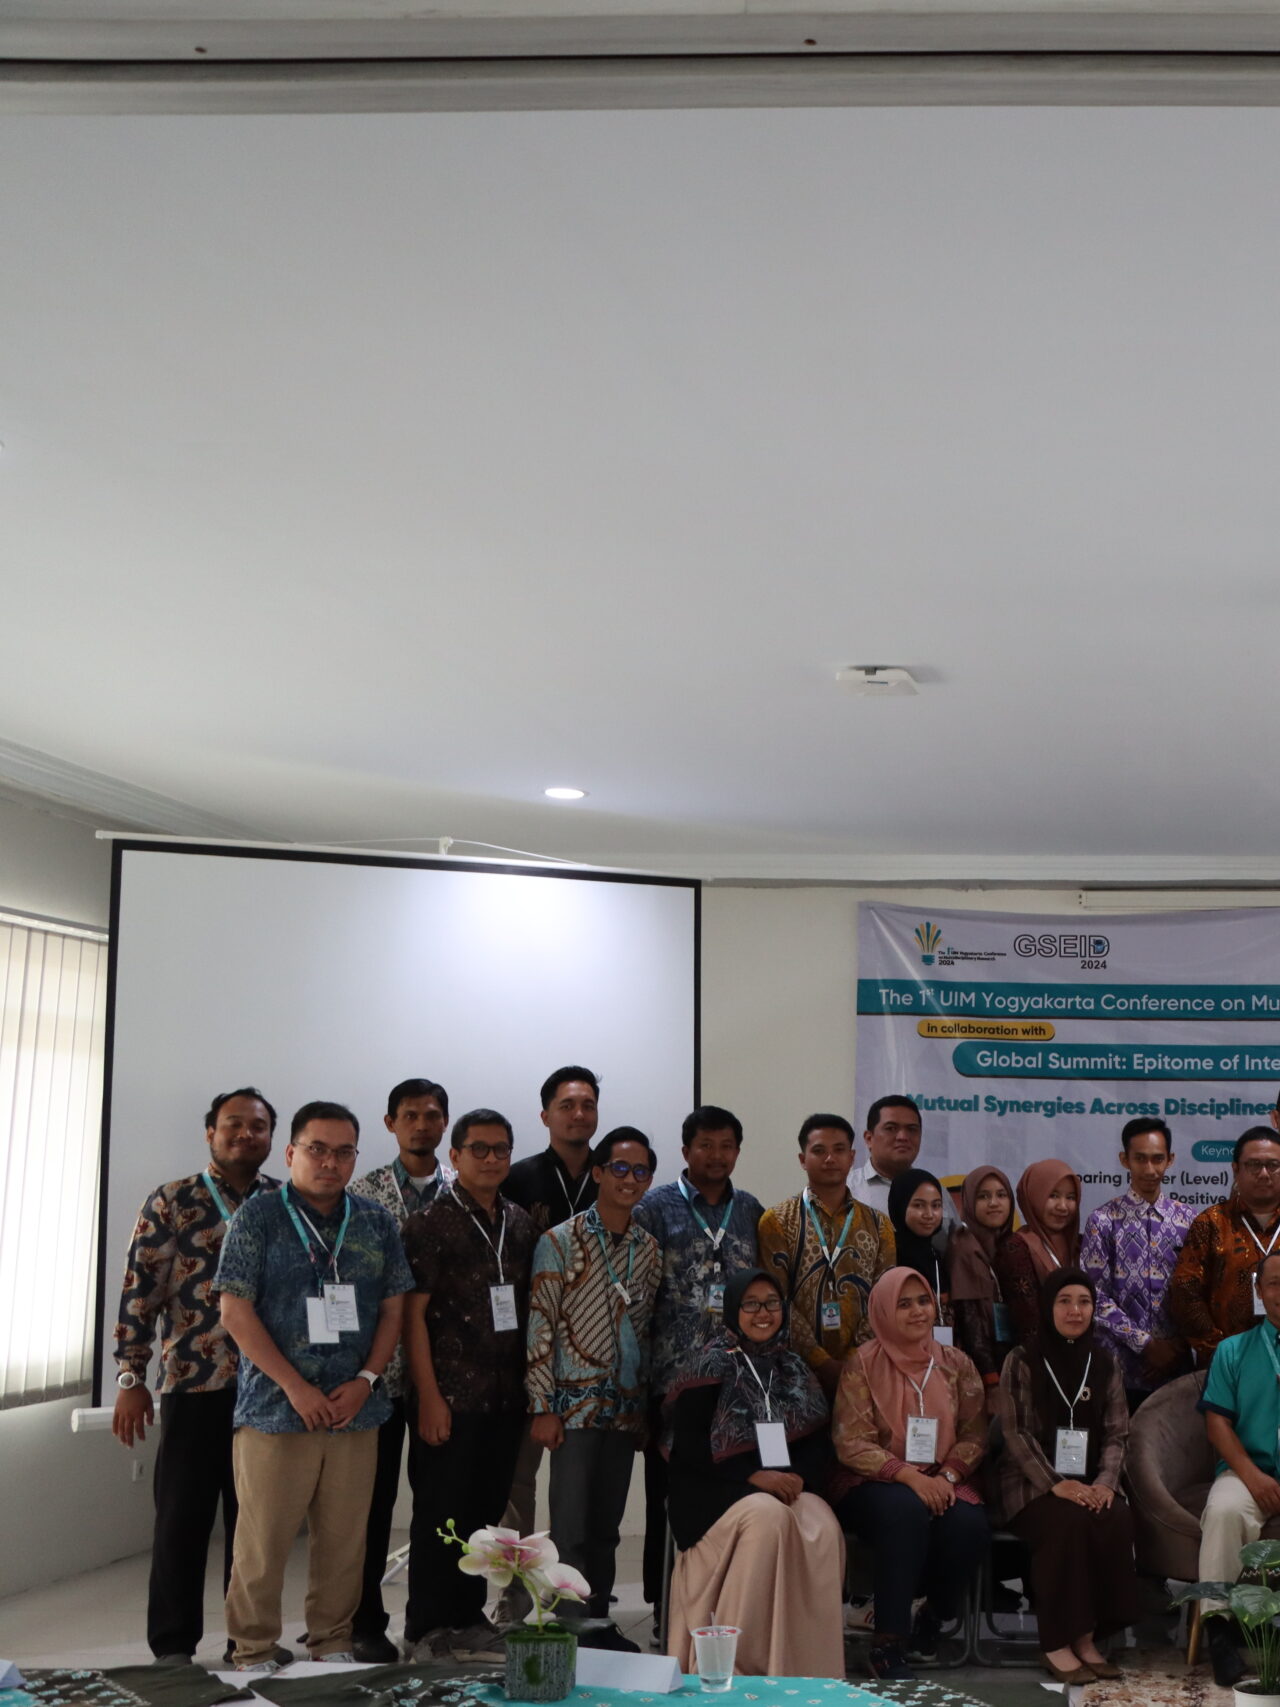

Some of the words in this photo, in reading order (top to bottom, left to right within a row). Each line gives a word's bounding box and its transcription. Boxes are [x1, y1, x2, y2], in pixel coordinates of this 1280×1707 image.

[1013, 934, 1110, 958] GSEID
[1080, 960, 1107, 970] 2024
[879, 988, 913, 1006] The
[940, 990, 976, 1008] UIM
[982, 992, 1095, 1013] Yogyakarta
[1100, 994, 1215, 1011] Conference
[1221, 998, 1246, 1011] on
[927, 1023, 938, 1033] in
[940, 1023, 1018, 1036] collaboration
[1021, 1025, 1046, 1036] with
[976, 1050, 1042, 1068] Global
[1048, 1053, 1127, 1070] Summit:
[1133, 1053, 1214, 1074] Epitome
[1219, 1053, 1240, 1071] of
[984, 1095, 1086, 1118] Synergies
[1089, 1097, 1160, 1115] Across
[1180, 1172, 1228, 1187] (Level)
[1170, 1192, 1227, 1205] Positive
